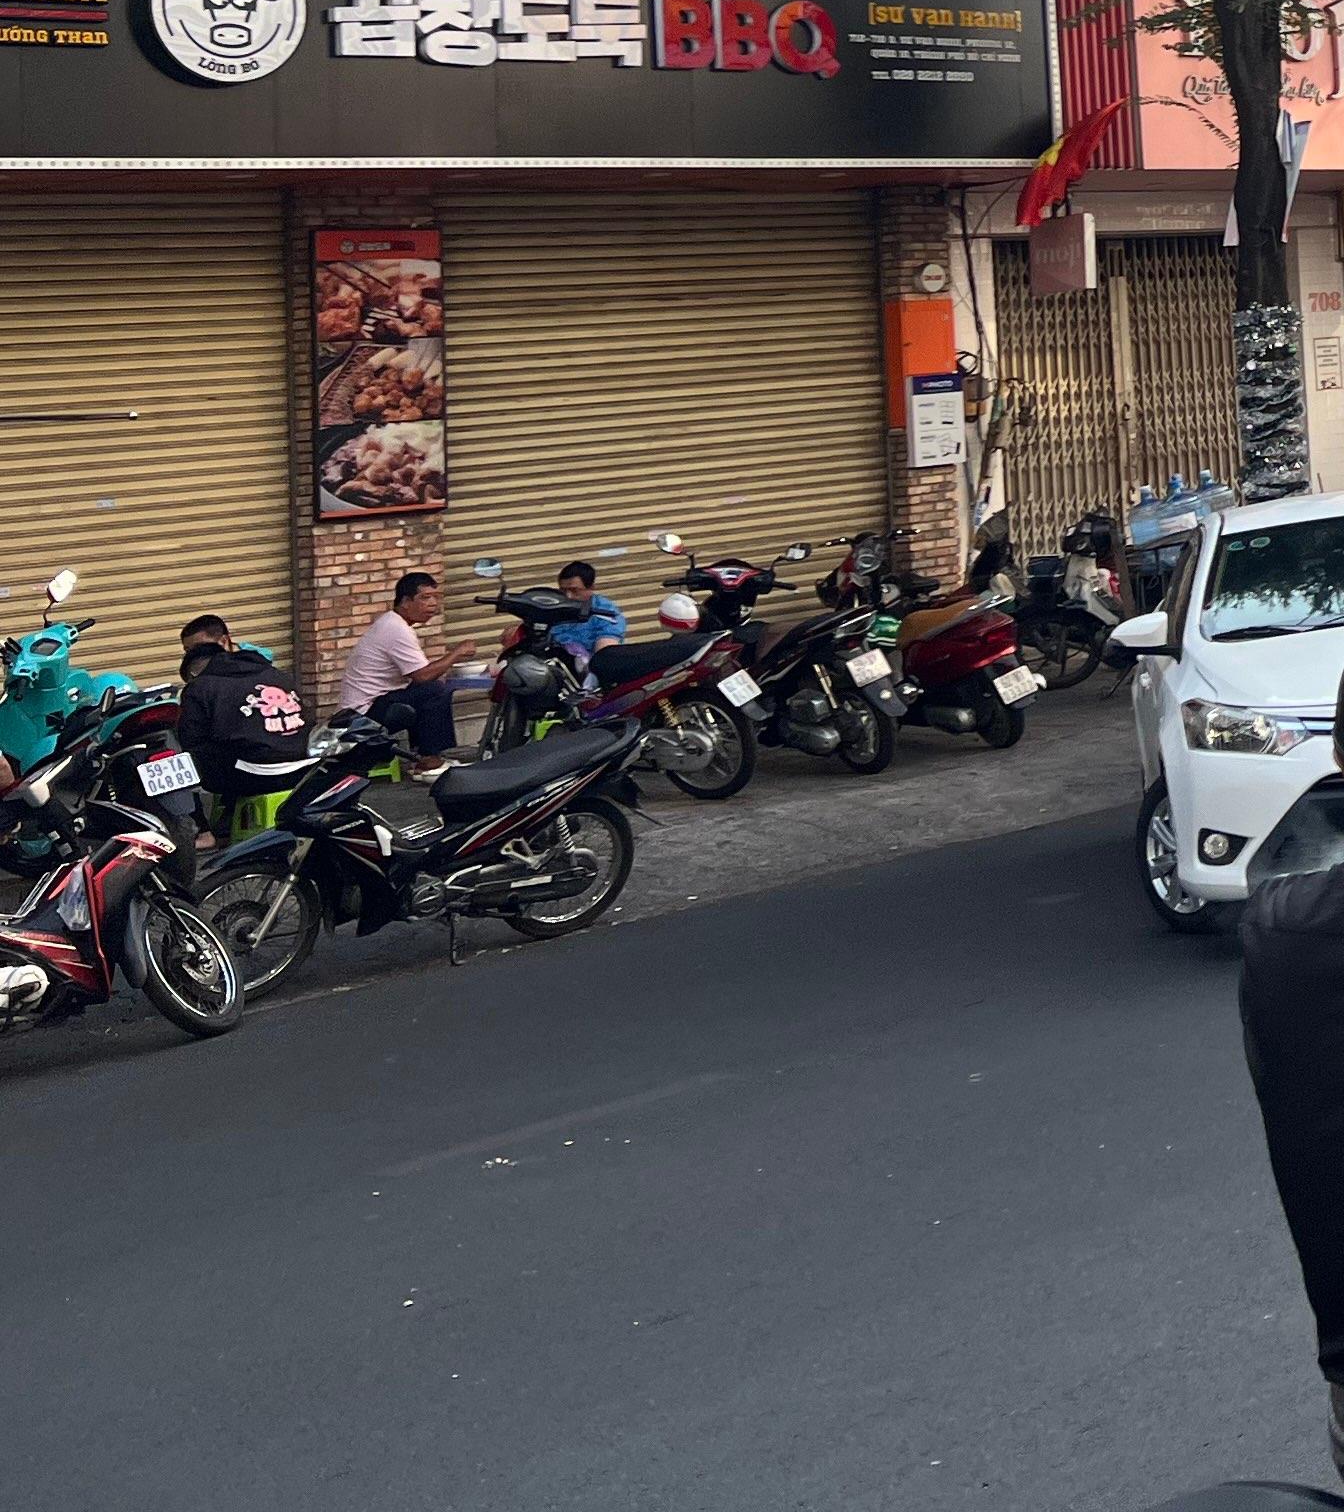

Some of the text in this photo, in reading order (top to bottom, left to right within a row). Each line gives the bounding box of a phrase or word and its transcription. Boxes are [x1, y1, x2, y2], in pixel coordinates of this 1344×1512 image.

[1308, 291, 1342, 313] 708
[145, 758, 185, 778] 59-TA
[147, 770, 194, 794] 04889
